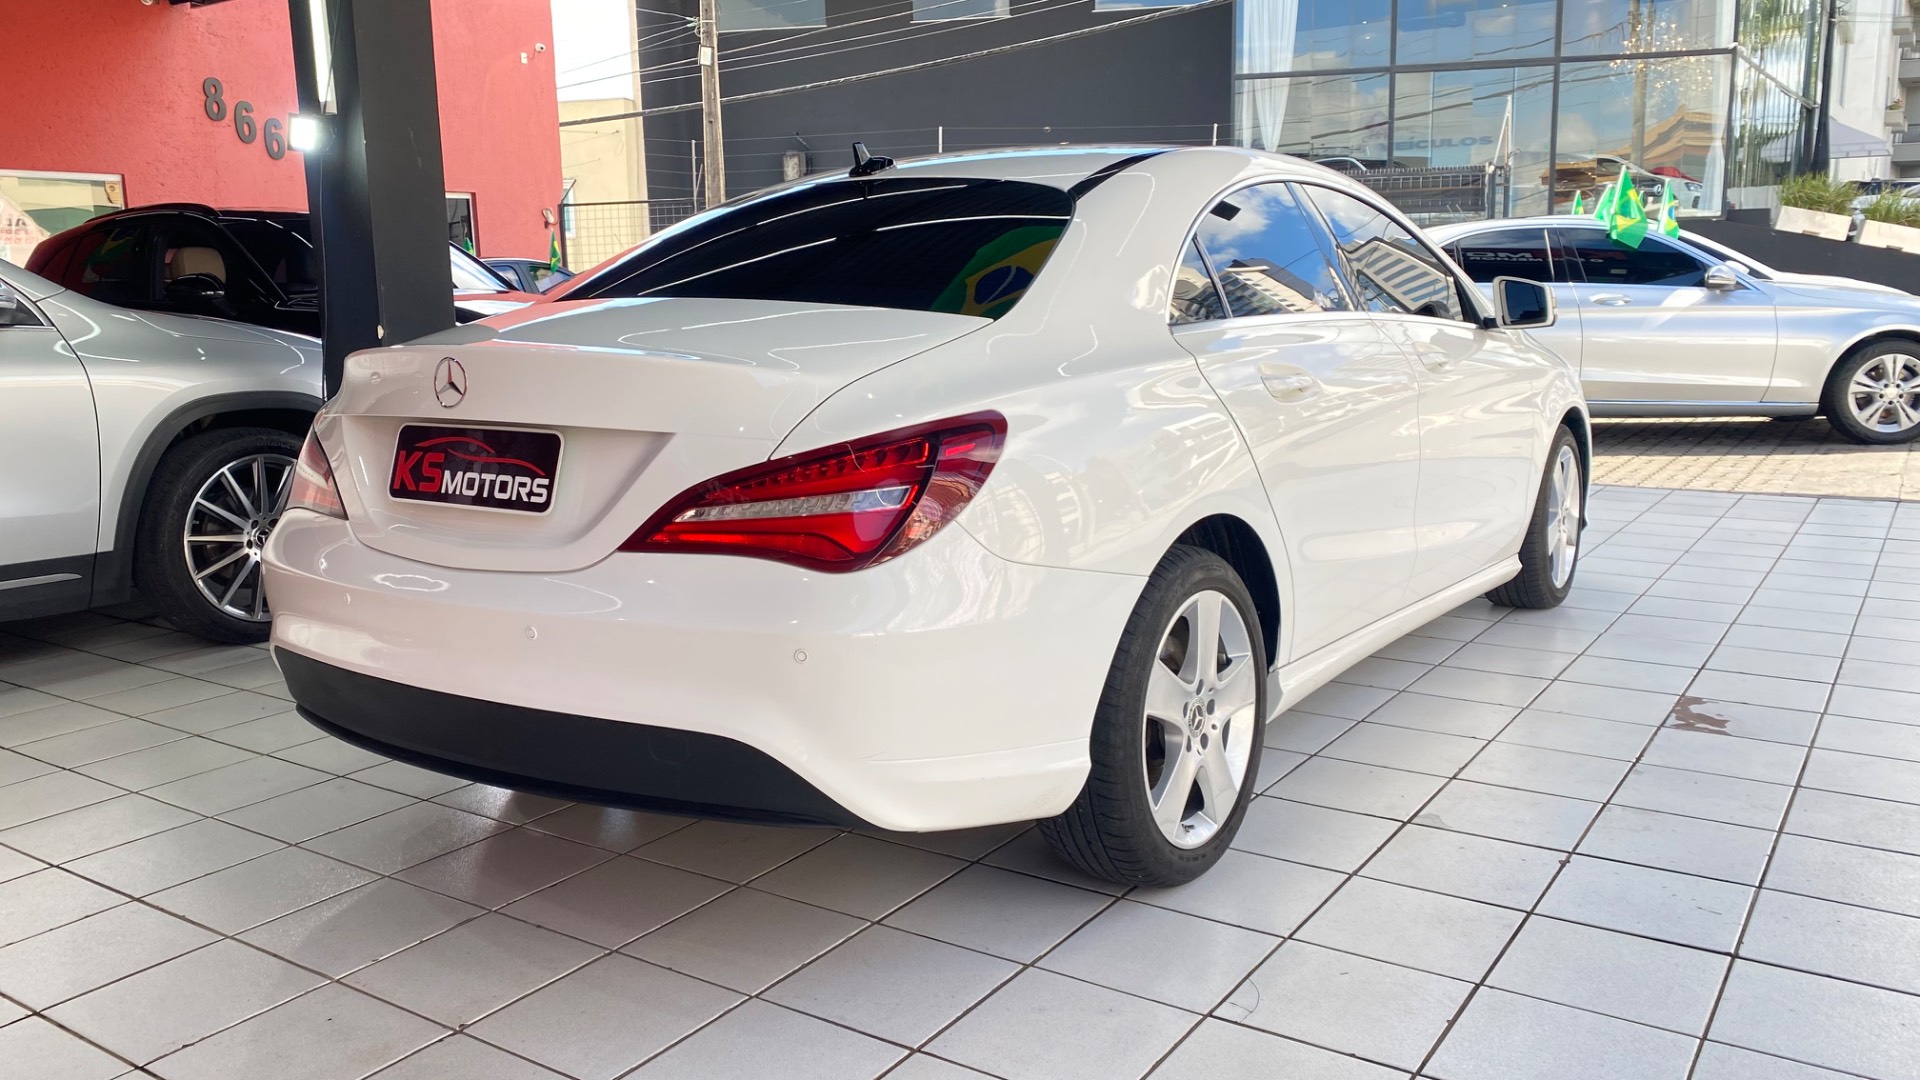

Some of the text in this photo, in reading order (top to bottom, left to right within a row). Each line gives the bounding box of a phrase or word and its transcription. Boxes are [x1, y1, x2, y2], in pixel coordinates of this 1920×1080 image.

[202, 77, 286, 160] 866
[393, 450, 550, 504] KS MOTORS
